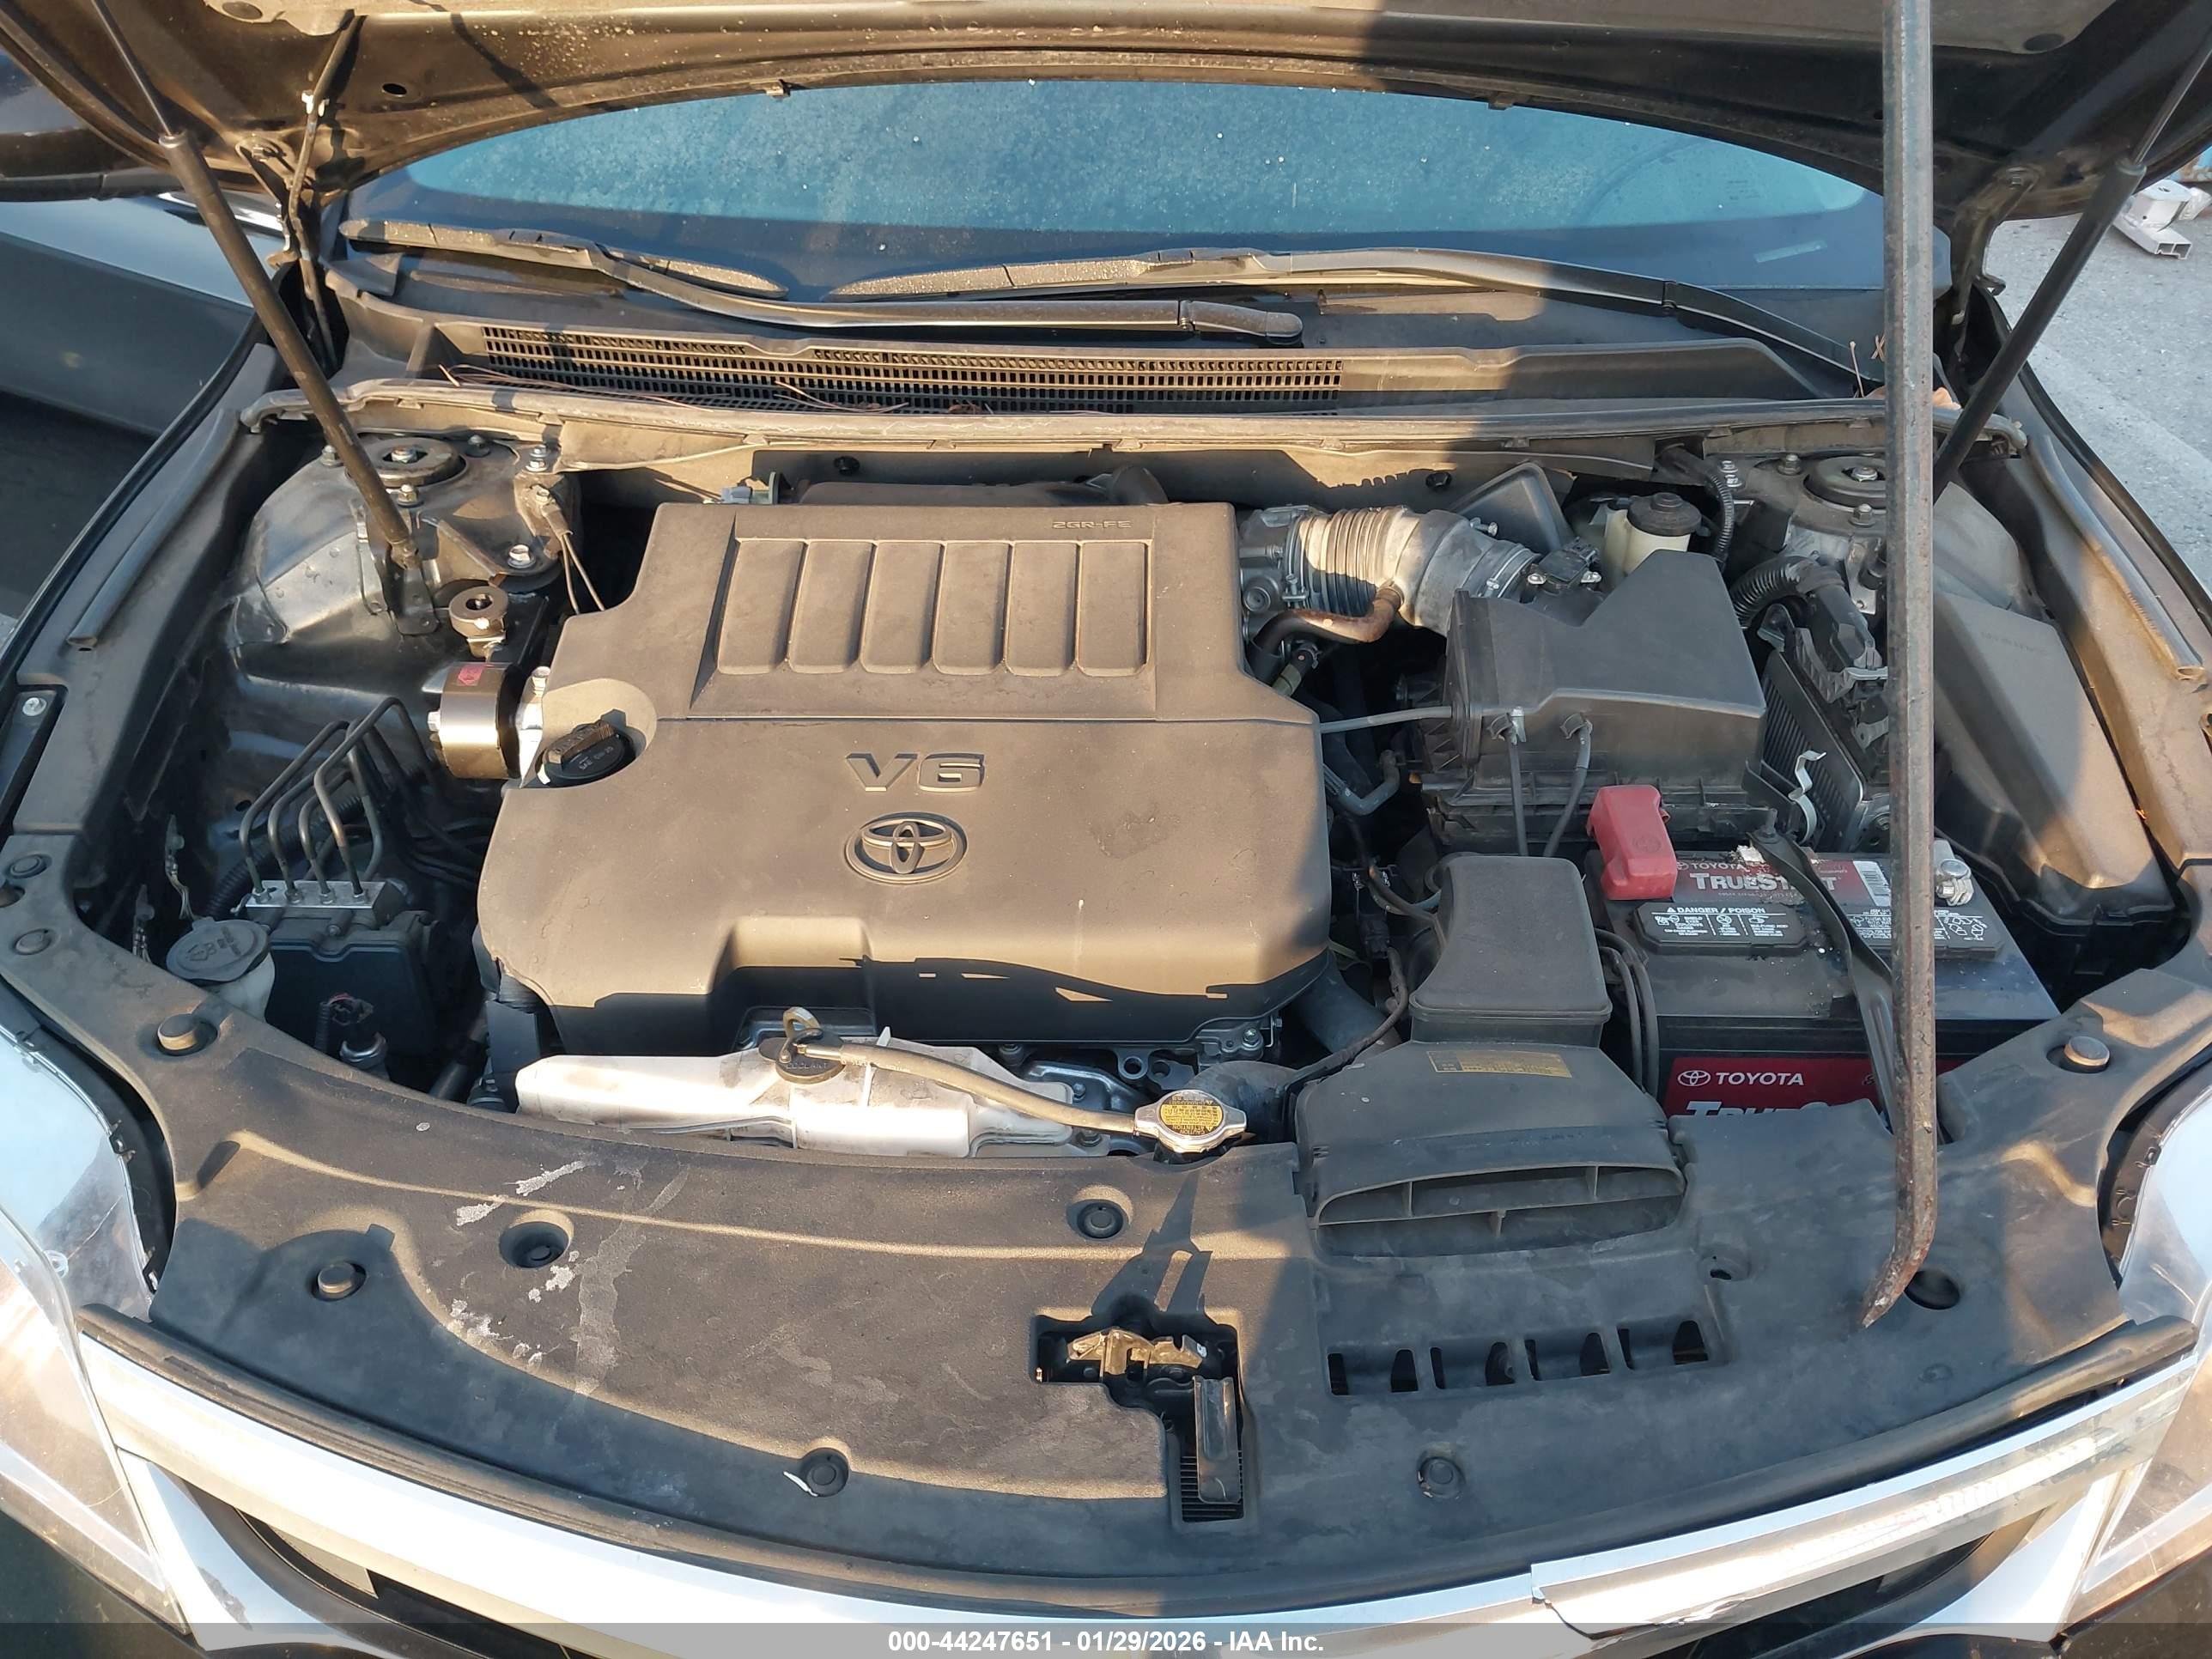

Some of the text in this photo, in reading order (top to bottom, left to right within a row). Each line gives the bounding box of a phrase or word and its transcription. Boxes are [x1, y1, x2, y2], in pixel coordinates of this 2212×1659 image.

[1052, 520, 1132, 530] 2GR-FE
[846, 752, 986, 793] V6
[1691, 861, 1748, 871] TOYOTA
[1716, 1073, 1805, 1085] TOYOTA
